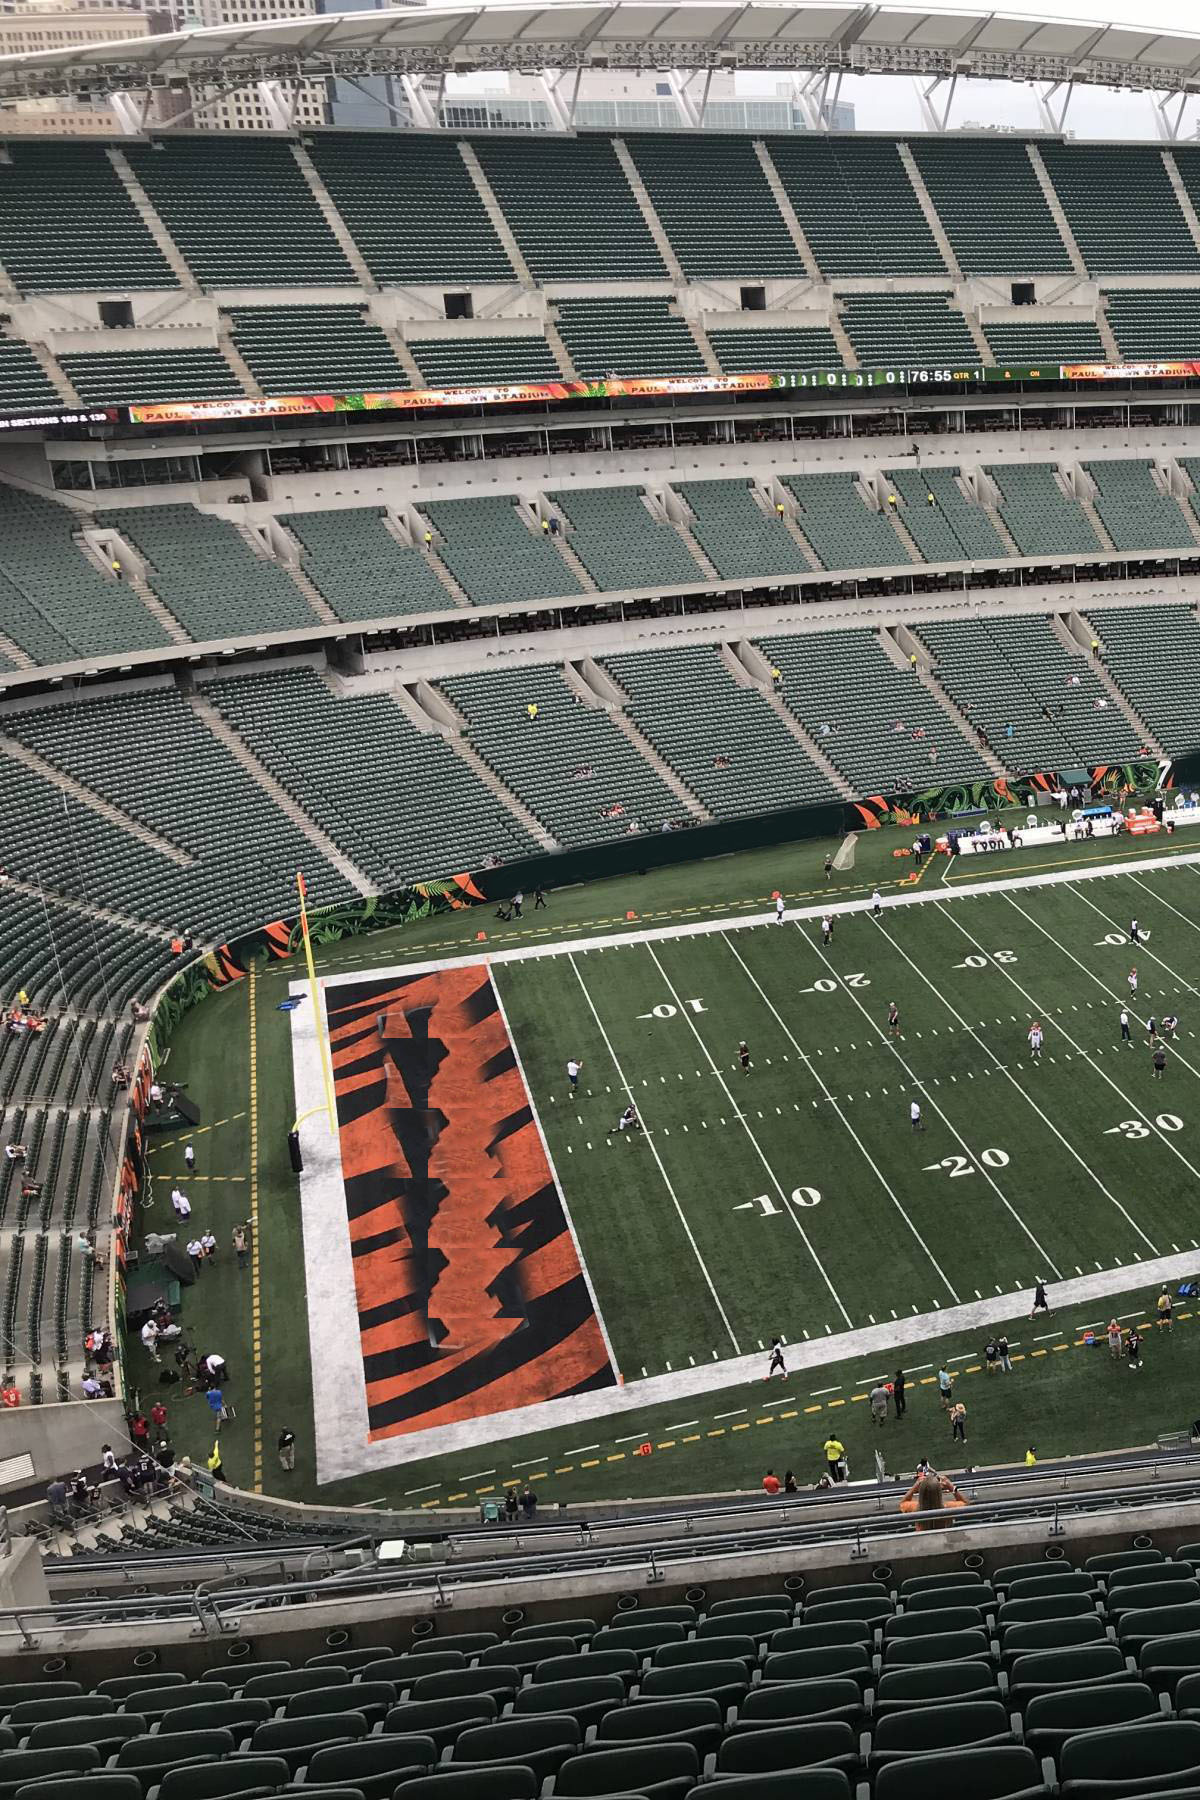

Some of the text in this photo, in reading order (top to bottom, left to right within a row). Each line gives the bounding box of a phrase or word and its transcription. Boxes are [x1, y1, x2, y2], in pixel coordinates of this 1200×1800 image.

[827, 373, 837, 385] 0
[886, 372, 895, 384] 0
[911, 370, 979, 382] 76:55 QTR 1
[403, 398, 434, 406] PAUL
[10, 416, 60, 427] SECTIONS
[146, 411, 182, 420] PAUL
[965, 950, 1018, 968] 30
[814, 973, 871, 992] 20
[652, 998, 708, 1018] 10
[1120, 1113, 1184, 1138] 30
[941, 1148, 1009, 1177] 20
[753, 1187, 821, 1217] 10
